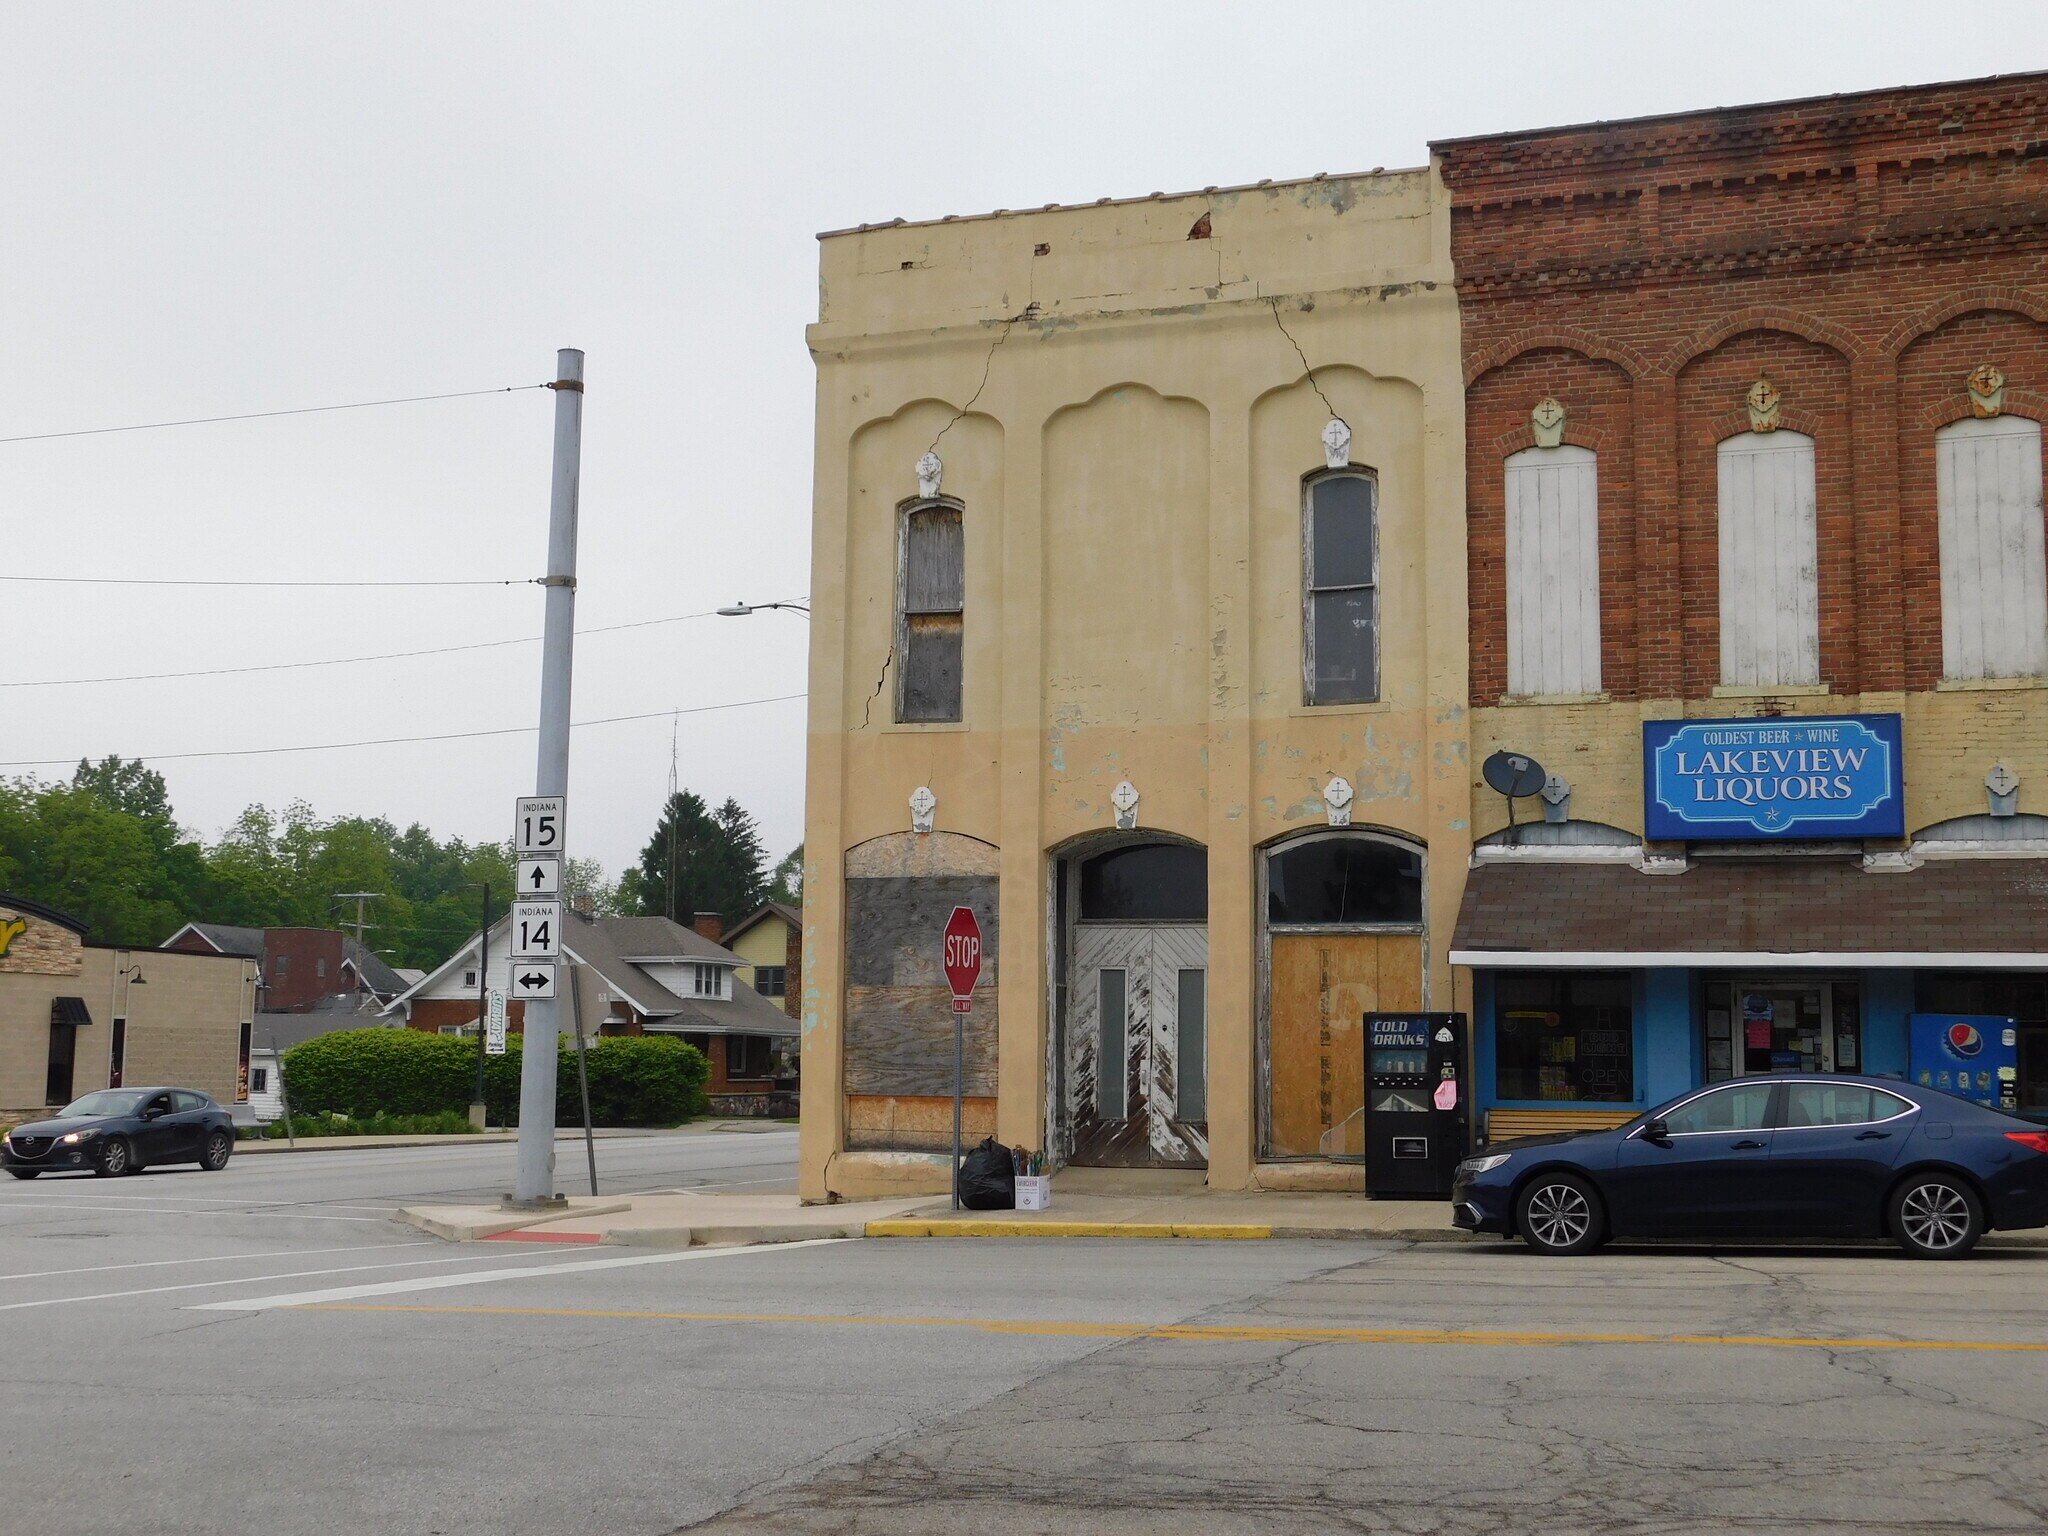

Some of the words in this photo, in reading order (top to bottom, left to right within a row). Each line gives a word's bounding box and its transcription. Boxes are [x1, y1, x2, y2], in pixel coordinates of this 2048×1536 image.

[1703, 731, 1755, 746] COLDEST
[1758, 730, 1790, 744] BEER
[1807, 729, 1840, 743] WINE
[1675, 747, 1869, 775] LAKEVIEW
[1694, 775, 1852, 805] LIQUORS
[523, 803, 557, 812] INDIANA
[524, 816, 556, 847] 15
[519, 907, 553, 916] INDIANA
[520, 920, 551, 951] 14
[946, 934, 979, 968] STOP
[491, 989, 504, 1042] SUBWAY
[1374, 1021, 1408, 1032] COLD
[1374, 1034, 1424, 1046] DRINKS
[1582, 1068, 1629, 1083] OPEN
